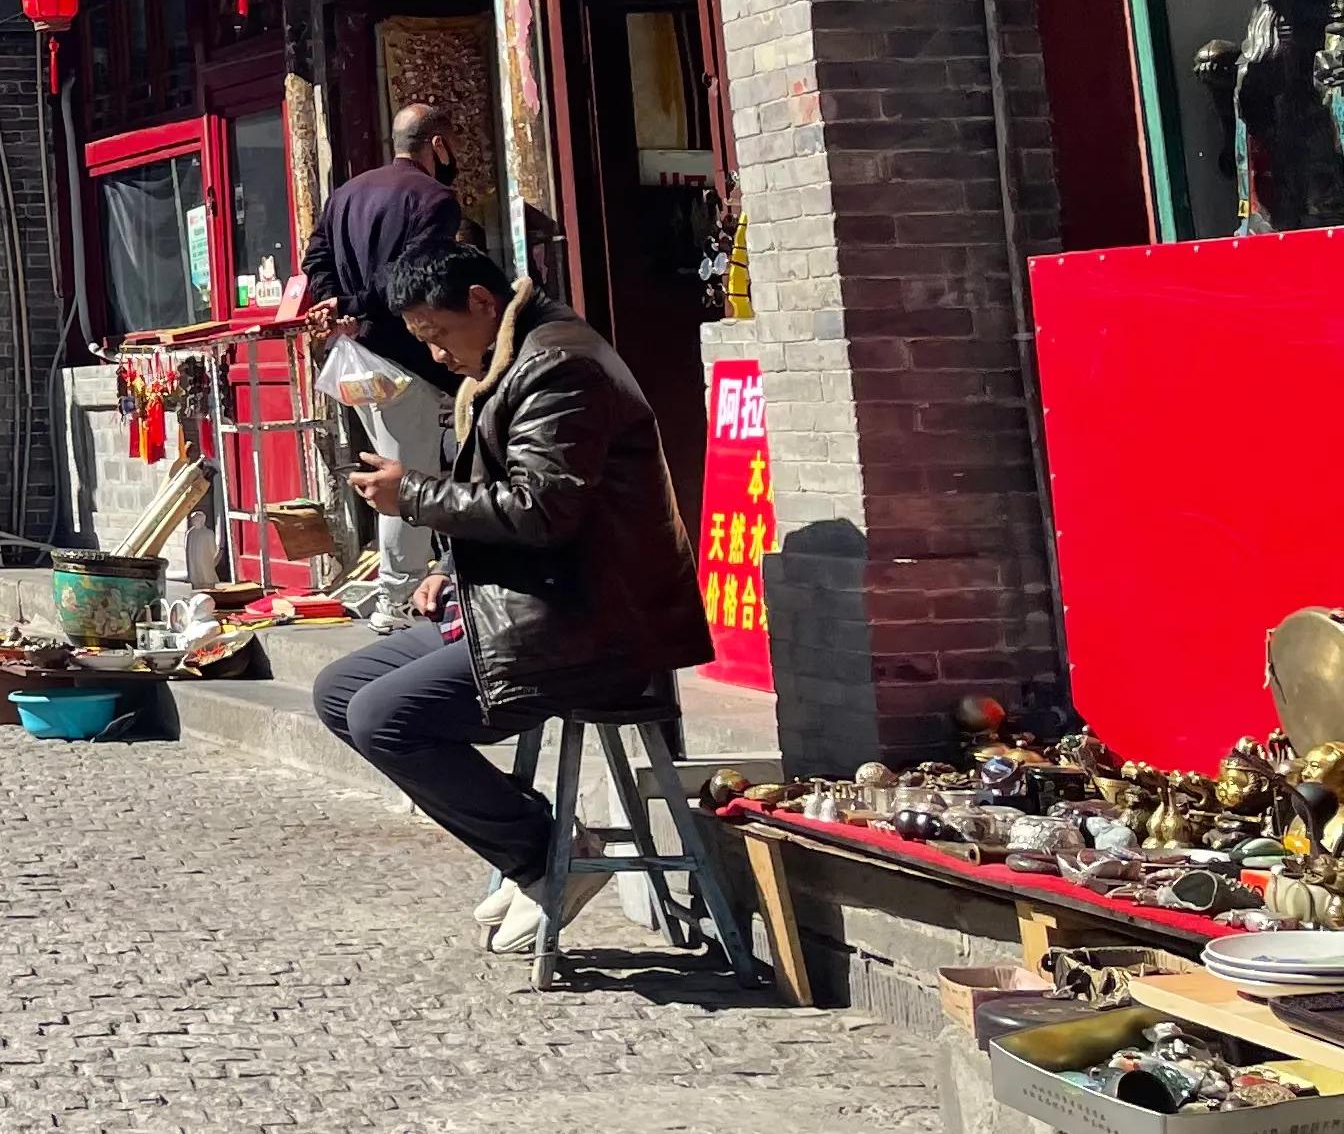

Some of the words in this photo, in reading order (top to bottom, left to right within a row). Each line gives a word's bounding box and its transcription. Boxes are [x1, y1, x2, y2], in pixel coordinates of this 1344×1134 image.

[715, 376, 766, 439] 阿拉
[708, 512, 780, 566] 天然水
